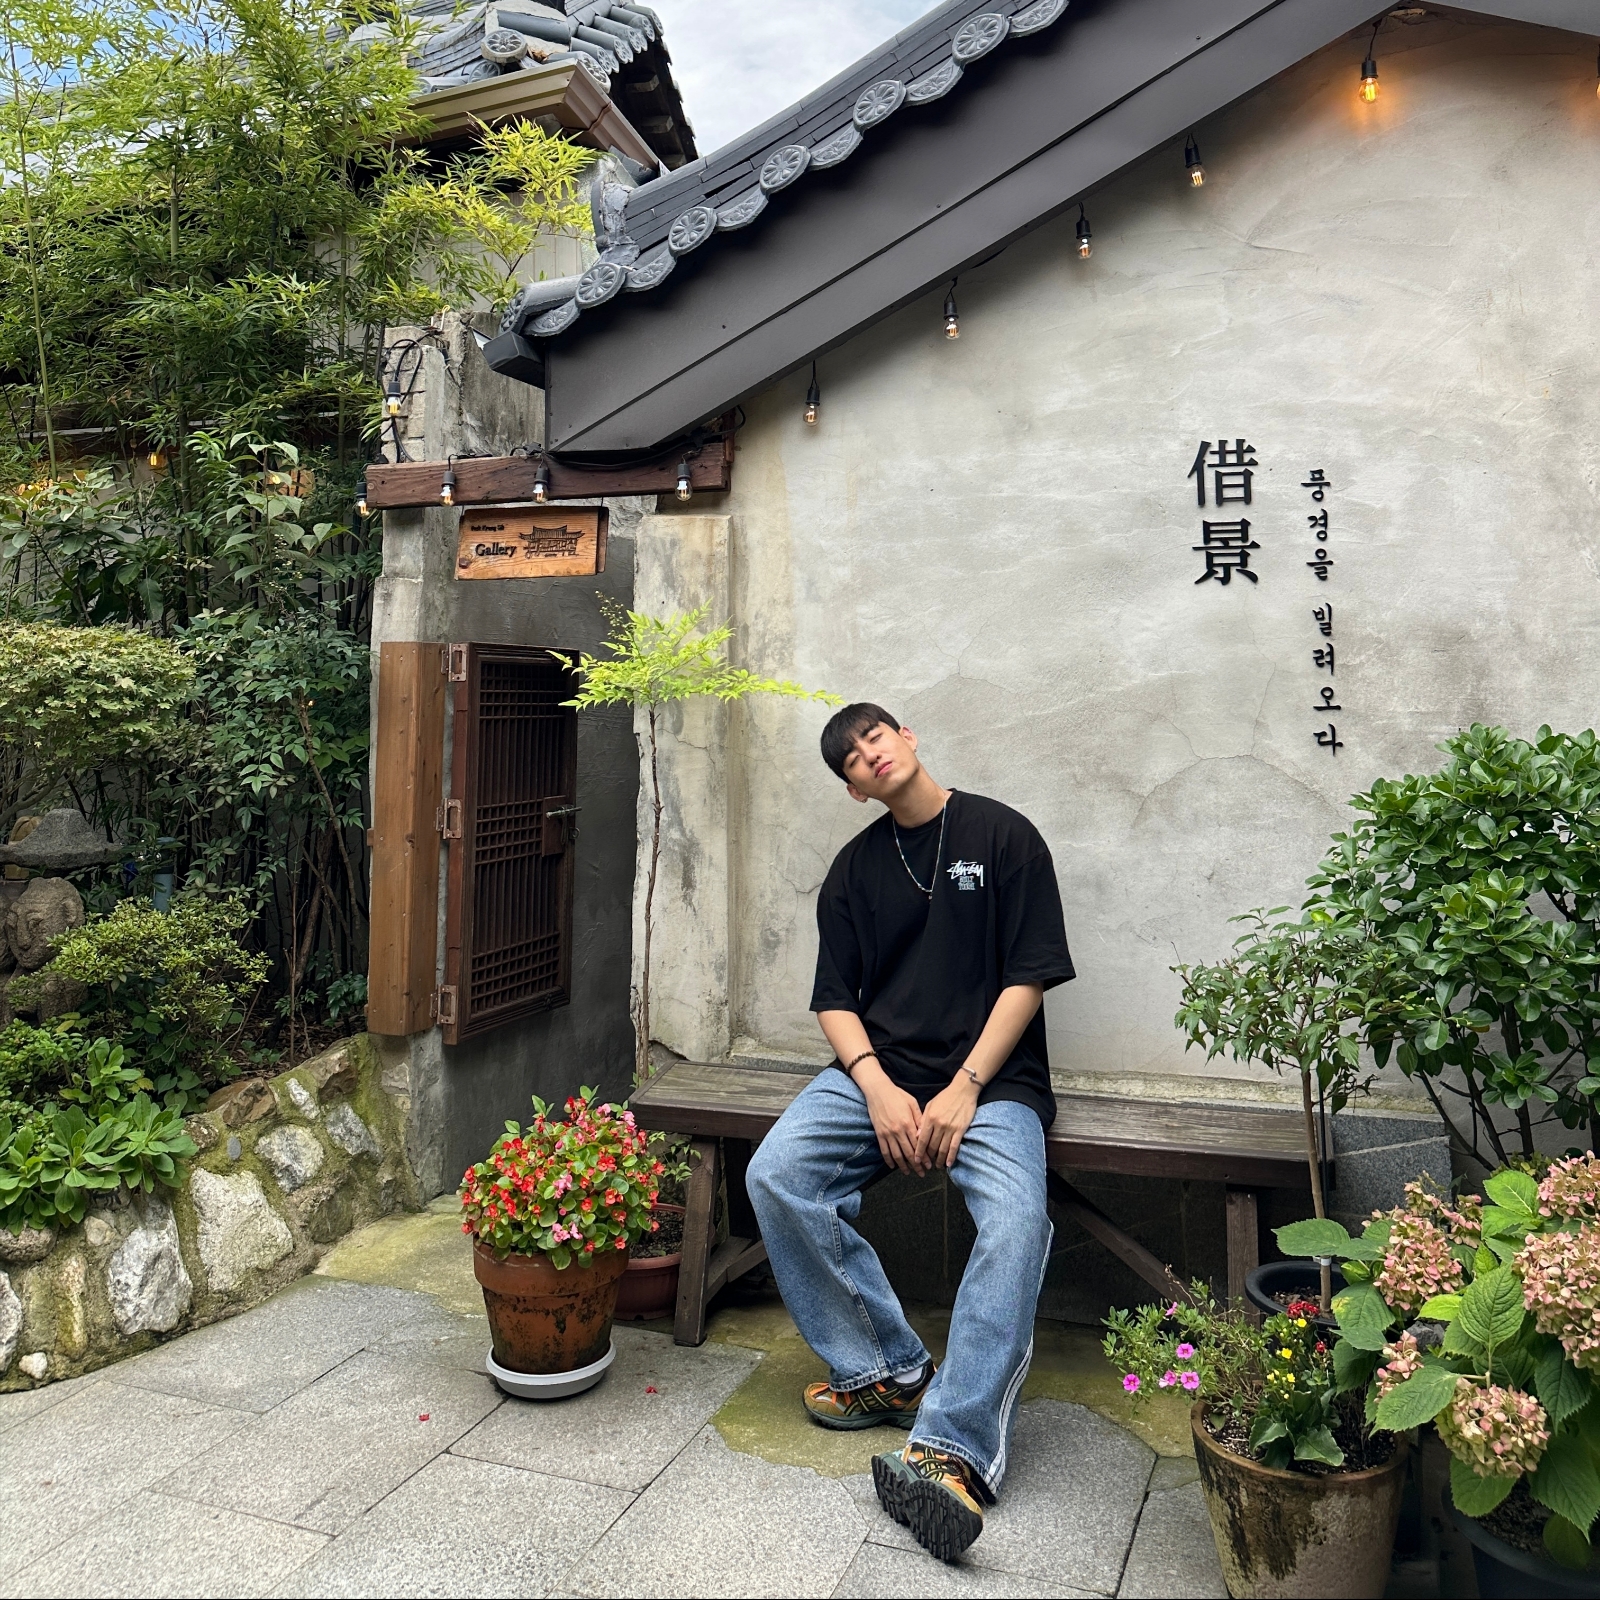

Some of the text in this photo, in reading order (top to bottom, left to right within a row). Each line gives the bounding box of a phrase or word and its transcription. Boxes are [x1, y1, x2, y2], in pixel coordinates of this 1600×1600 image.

[475, 542, 517, 558] Gallery
[1187, 438, 1261, 586] 借景
[1300, 468, 1344, 758] 풍경을 빌려오다
